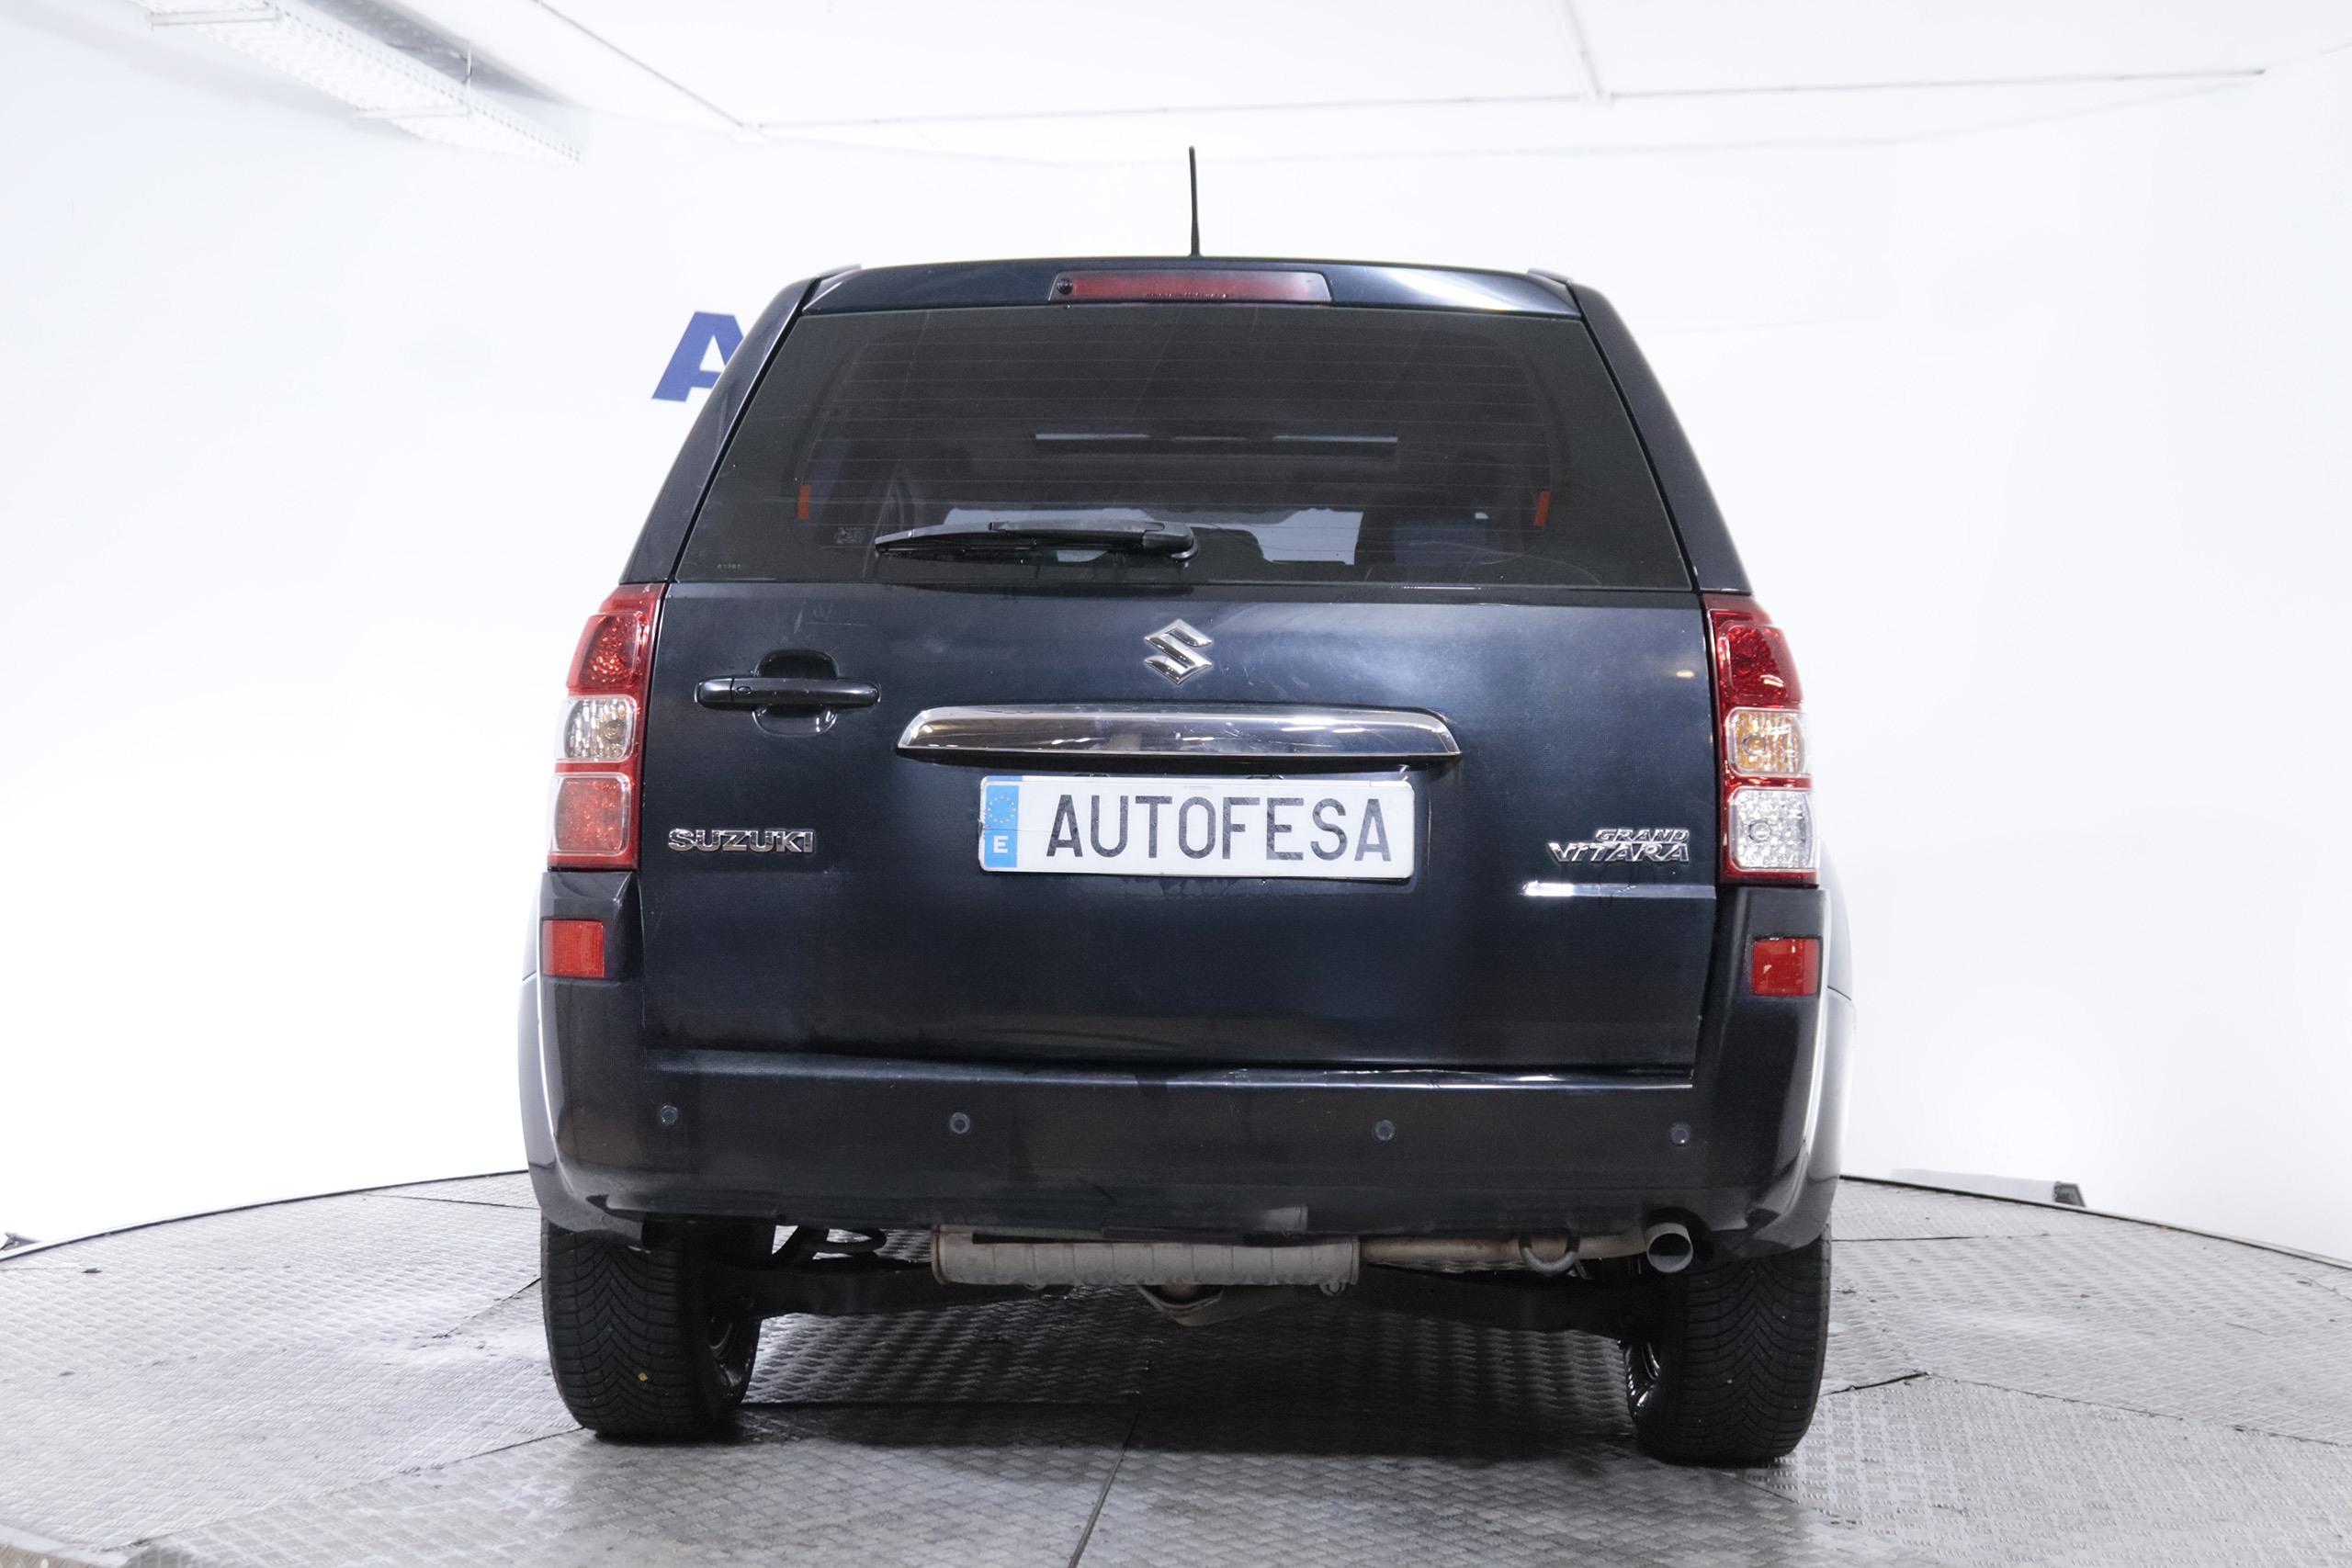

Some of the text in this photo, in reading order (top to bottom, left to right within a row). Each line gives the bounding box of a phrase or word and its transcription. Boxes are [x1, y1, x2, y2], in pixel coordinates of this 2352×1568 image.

[1046, 794, 1392, 862] AUTOFESA
[1596, 829, 1690, 842] GRAND
[668, 829, 814, 853] SUZUKI
[993, 836, 1009, 853] E
[1547, 842, 1690, 863] VITARA
